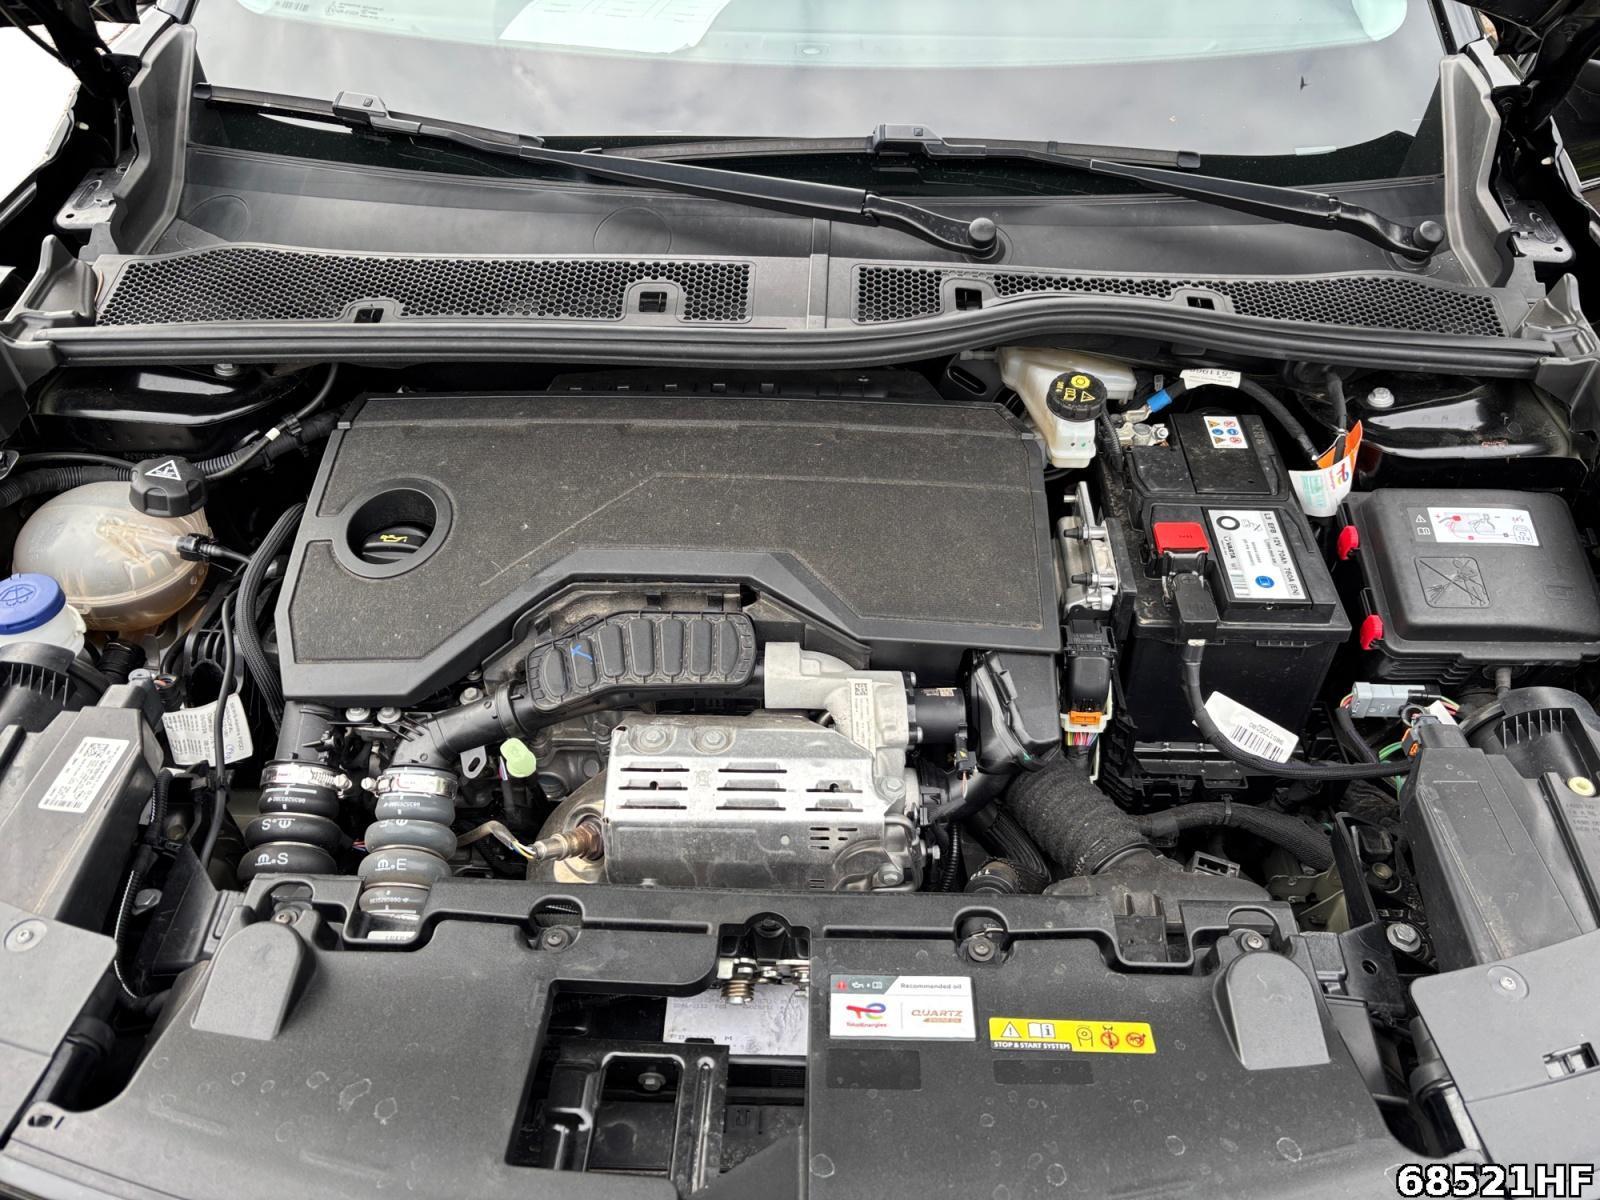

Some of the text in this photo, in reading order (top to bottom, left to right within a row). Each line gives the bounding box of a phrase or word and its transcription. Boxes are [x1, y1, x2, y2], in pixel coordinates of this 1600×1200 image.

[900, 982, 952, 990] Recommended
[911, 1009, 963, 1017] QUARTZ
[993, 1041, 1013, 1049] STOP
[1019, 1042, 1042, 1050] START
